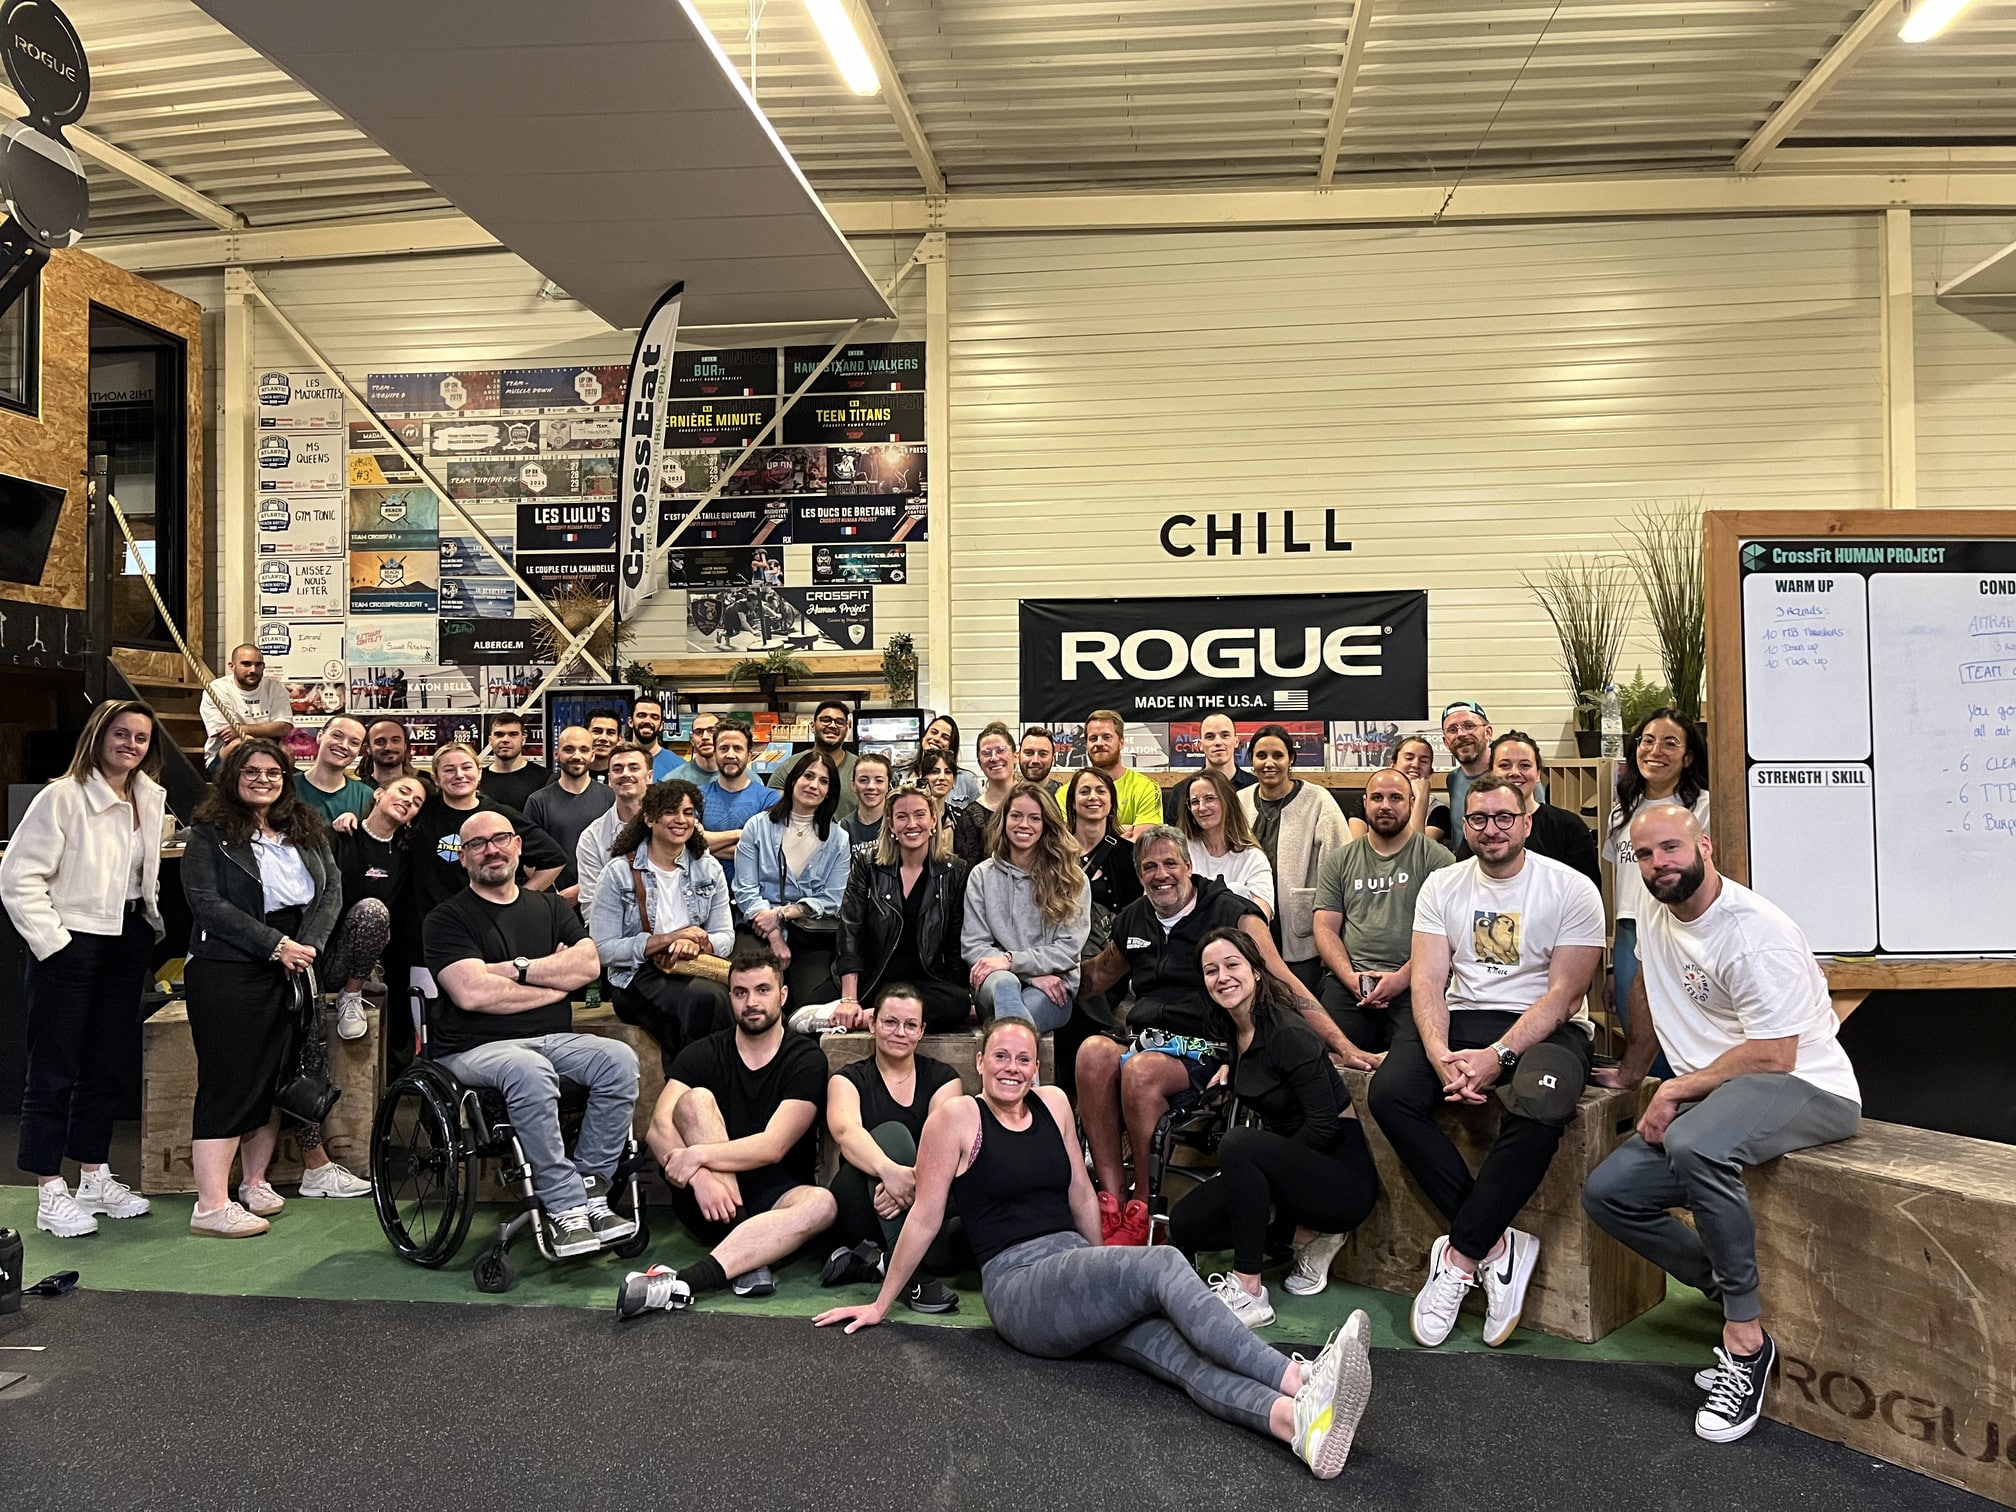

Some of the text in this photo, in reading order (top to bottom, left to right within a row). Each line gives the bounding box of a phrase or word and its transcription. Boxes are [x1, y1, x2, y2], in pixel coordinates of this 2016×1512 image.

[14, 34, 77, 82] ROGUE
[868, 359, 918, 371] WALKERS
[306, 379, 320, 387] LES
[666, 413, 762, 427] ERNIÈRE MINUTE
[816, 408, 891, 422] TEEN TITANS
[306, 443, 320, 452] MS
[296, 453, 330, 464] QUEENS
[622, 344, 662, 590] CrossEat
[710, 466, 718, 474] 28
[356, 470, 370, 480] #3
[570, 471, 579, 479] 28
[710, 475, 718, 483] 29
[570, 480, 579, 488] 29
[295, 510, 336, 522] GYM TONIC
[535, 507, 610, 524] LES LULU'S
[801, 506, 896, 518] LES DUCS DE BRETAGNE
[1160, 509, 1352, 557] CHILL
[1773, 548, 1946, 563] CrossFit HUMAN PROJECT
[295, 565, 332, 576] LAISSEZ
[304, 577, 327, 586] NOUS
[1776, 580, 1834, 593] WARM UP
[297, 586, 328, 595] LIFTER
[806, 591, 870, 601] CROSSFIT
[806, 603, 870, 616] Human Project
[1776, 607, 1784, 617] 3
[1762, 629, 1777, 640] 10
[474, 641, 524, 649] ALBERGE.M
[1765, 645, 1778, 654] 10
[1061, 626, 1382, 681] ROGUE
[1765, 659, 1778, 668] 10
[1966, 666, 2000, 680] TEAM
[351, 678, 395, 686] ATLANTIC
[407, 682, 472, 692] KATON BELLS
[1134, 694, 1268, 710] MADE IN THE U.S.A.
[1968, 704, 1989, 721] You
[1974, 725, 2011, 737] all out
[1336, 733, 1387, 742] ATLANTIC
[1960, 754, 1969, 772] 6
[1758, 771, 1865, 784] STRENGTH SKILL
[1960, 783, 1968, 803] 6
[1963, 811, 1971, 831] 6
[1354, 872, 1409, 890] BUILD
[1770, 1353, 2016, 1464] ROGU
